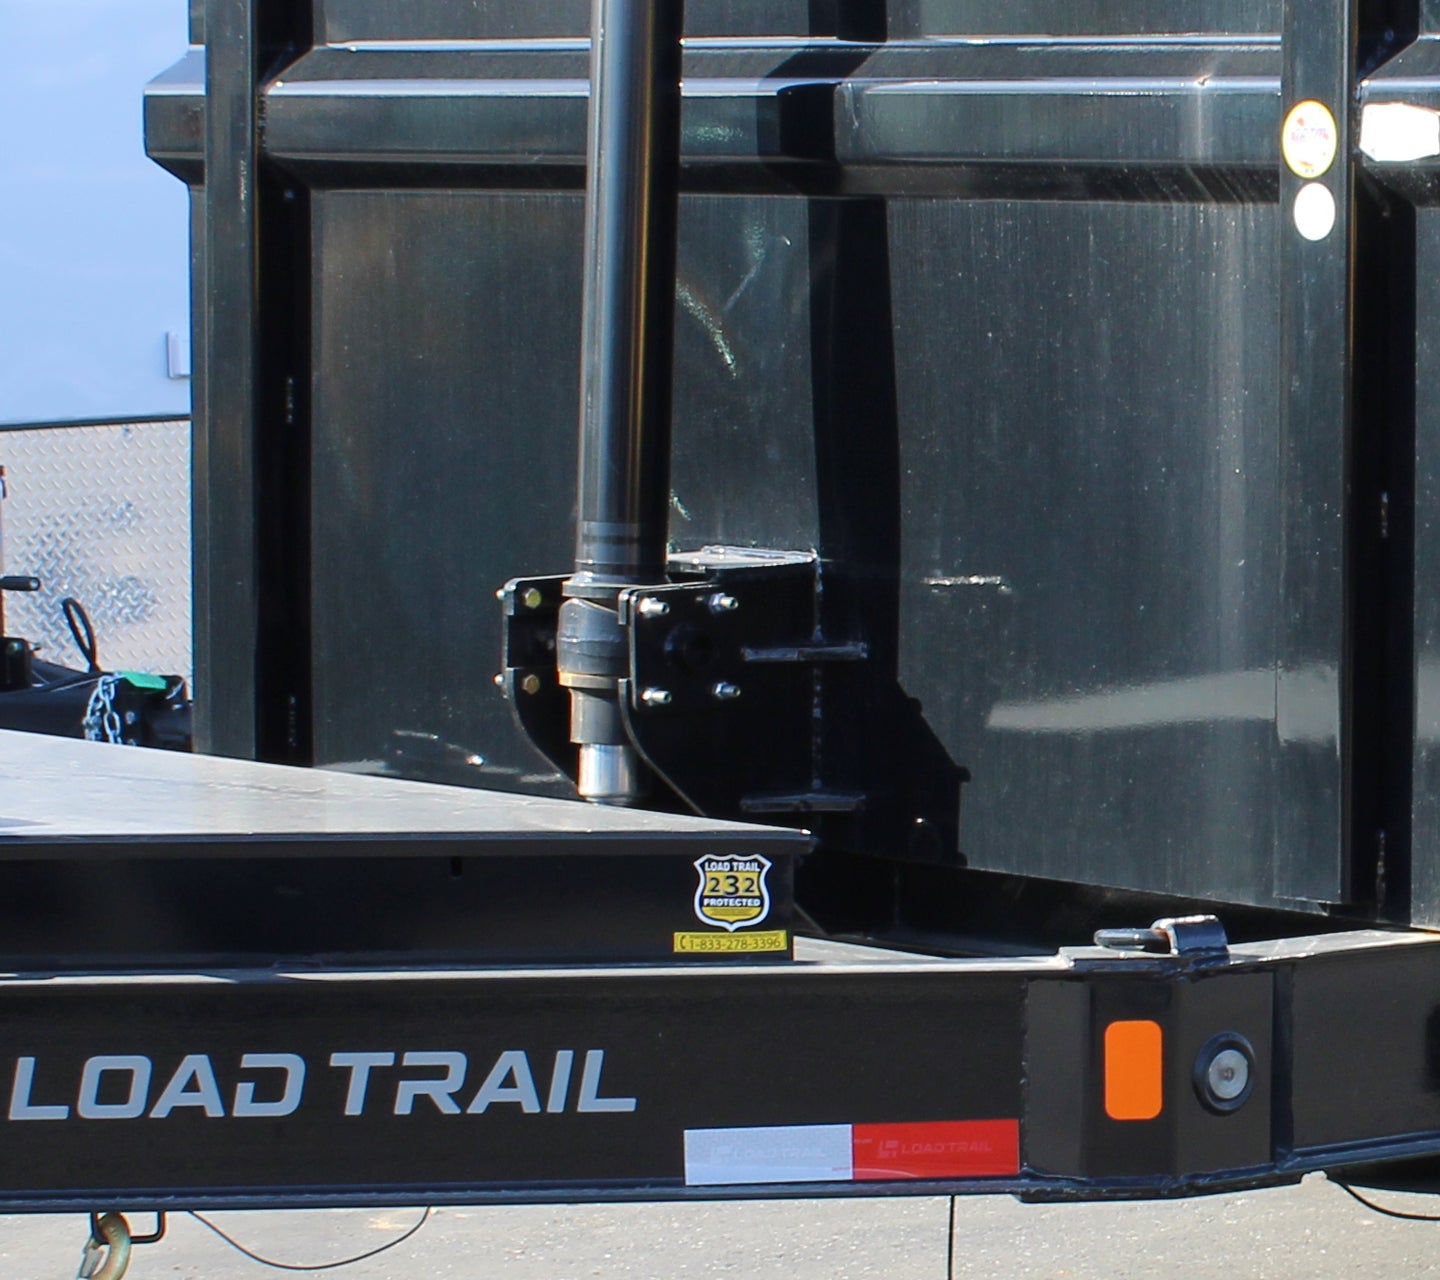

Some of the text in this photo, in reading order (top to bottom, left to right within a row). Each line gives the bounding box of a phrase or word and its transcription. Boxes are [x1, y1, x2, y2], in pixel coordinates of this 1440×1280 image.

[704, 861, 761, 872] LOAD TRAIL
[703, 897, 761, 907] PROTECTED
[690, 938, 781, 951] 1-833-278-3396
[7, 1049, 637, 1121] LOAD TRAIL
[901, 1142, 945, 1154] LOAD
